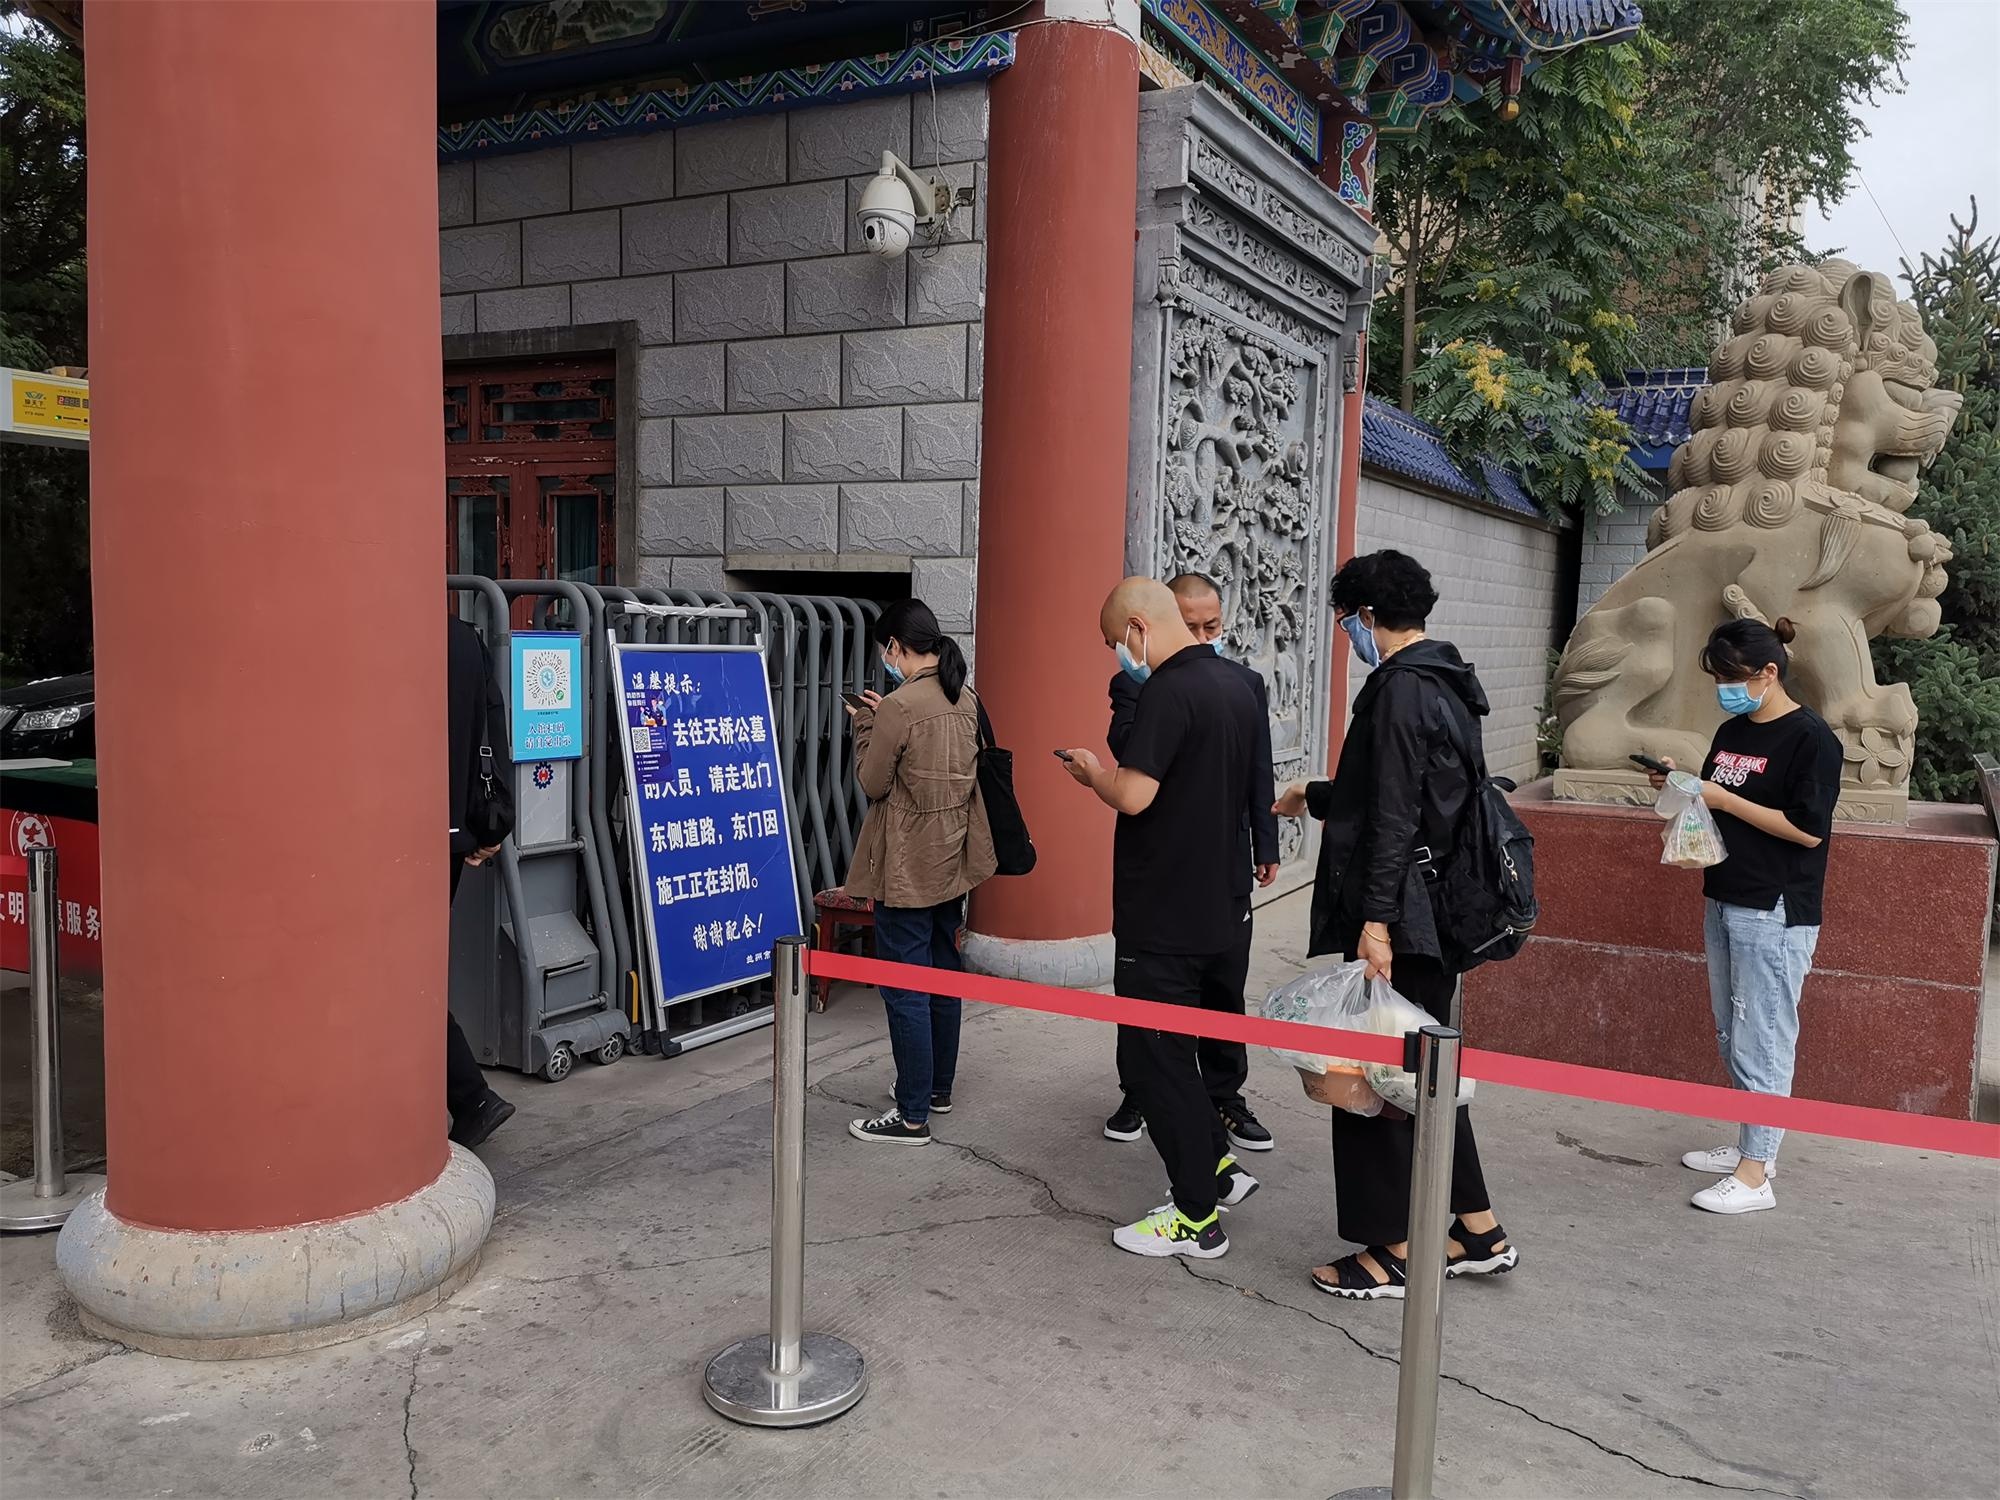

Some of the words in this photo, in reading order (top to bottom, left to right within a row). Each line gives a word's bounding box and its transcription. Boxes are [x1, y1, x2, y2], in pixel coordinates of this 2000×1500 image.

[672, 715, 767, 747] 去往天桥公墓
[1715, 753, 1737, 766] PAUL
[1735, 757, 1765, 771] FRANK
[649, 809, 779, 853] 东侧道路，东门因
[656, 863, 759, 906] 施工正在封闭。
[692, 913, 763, 951] 谢谢配合！
